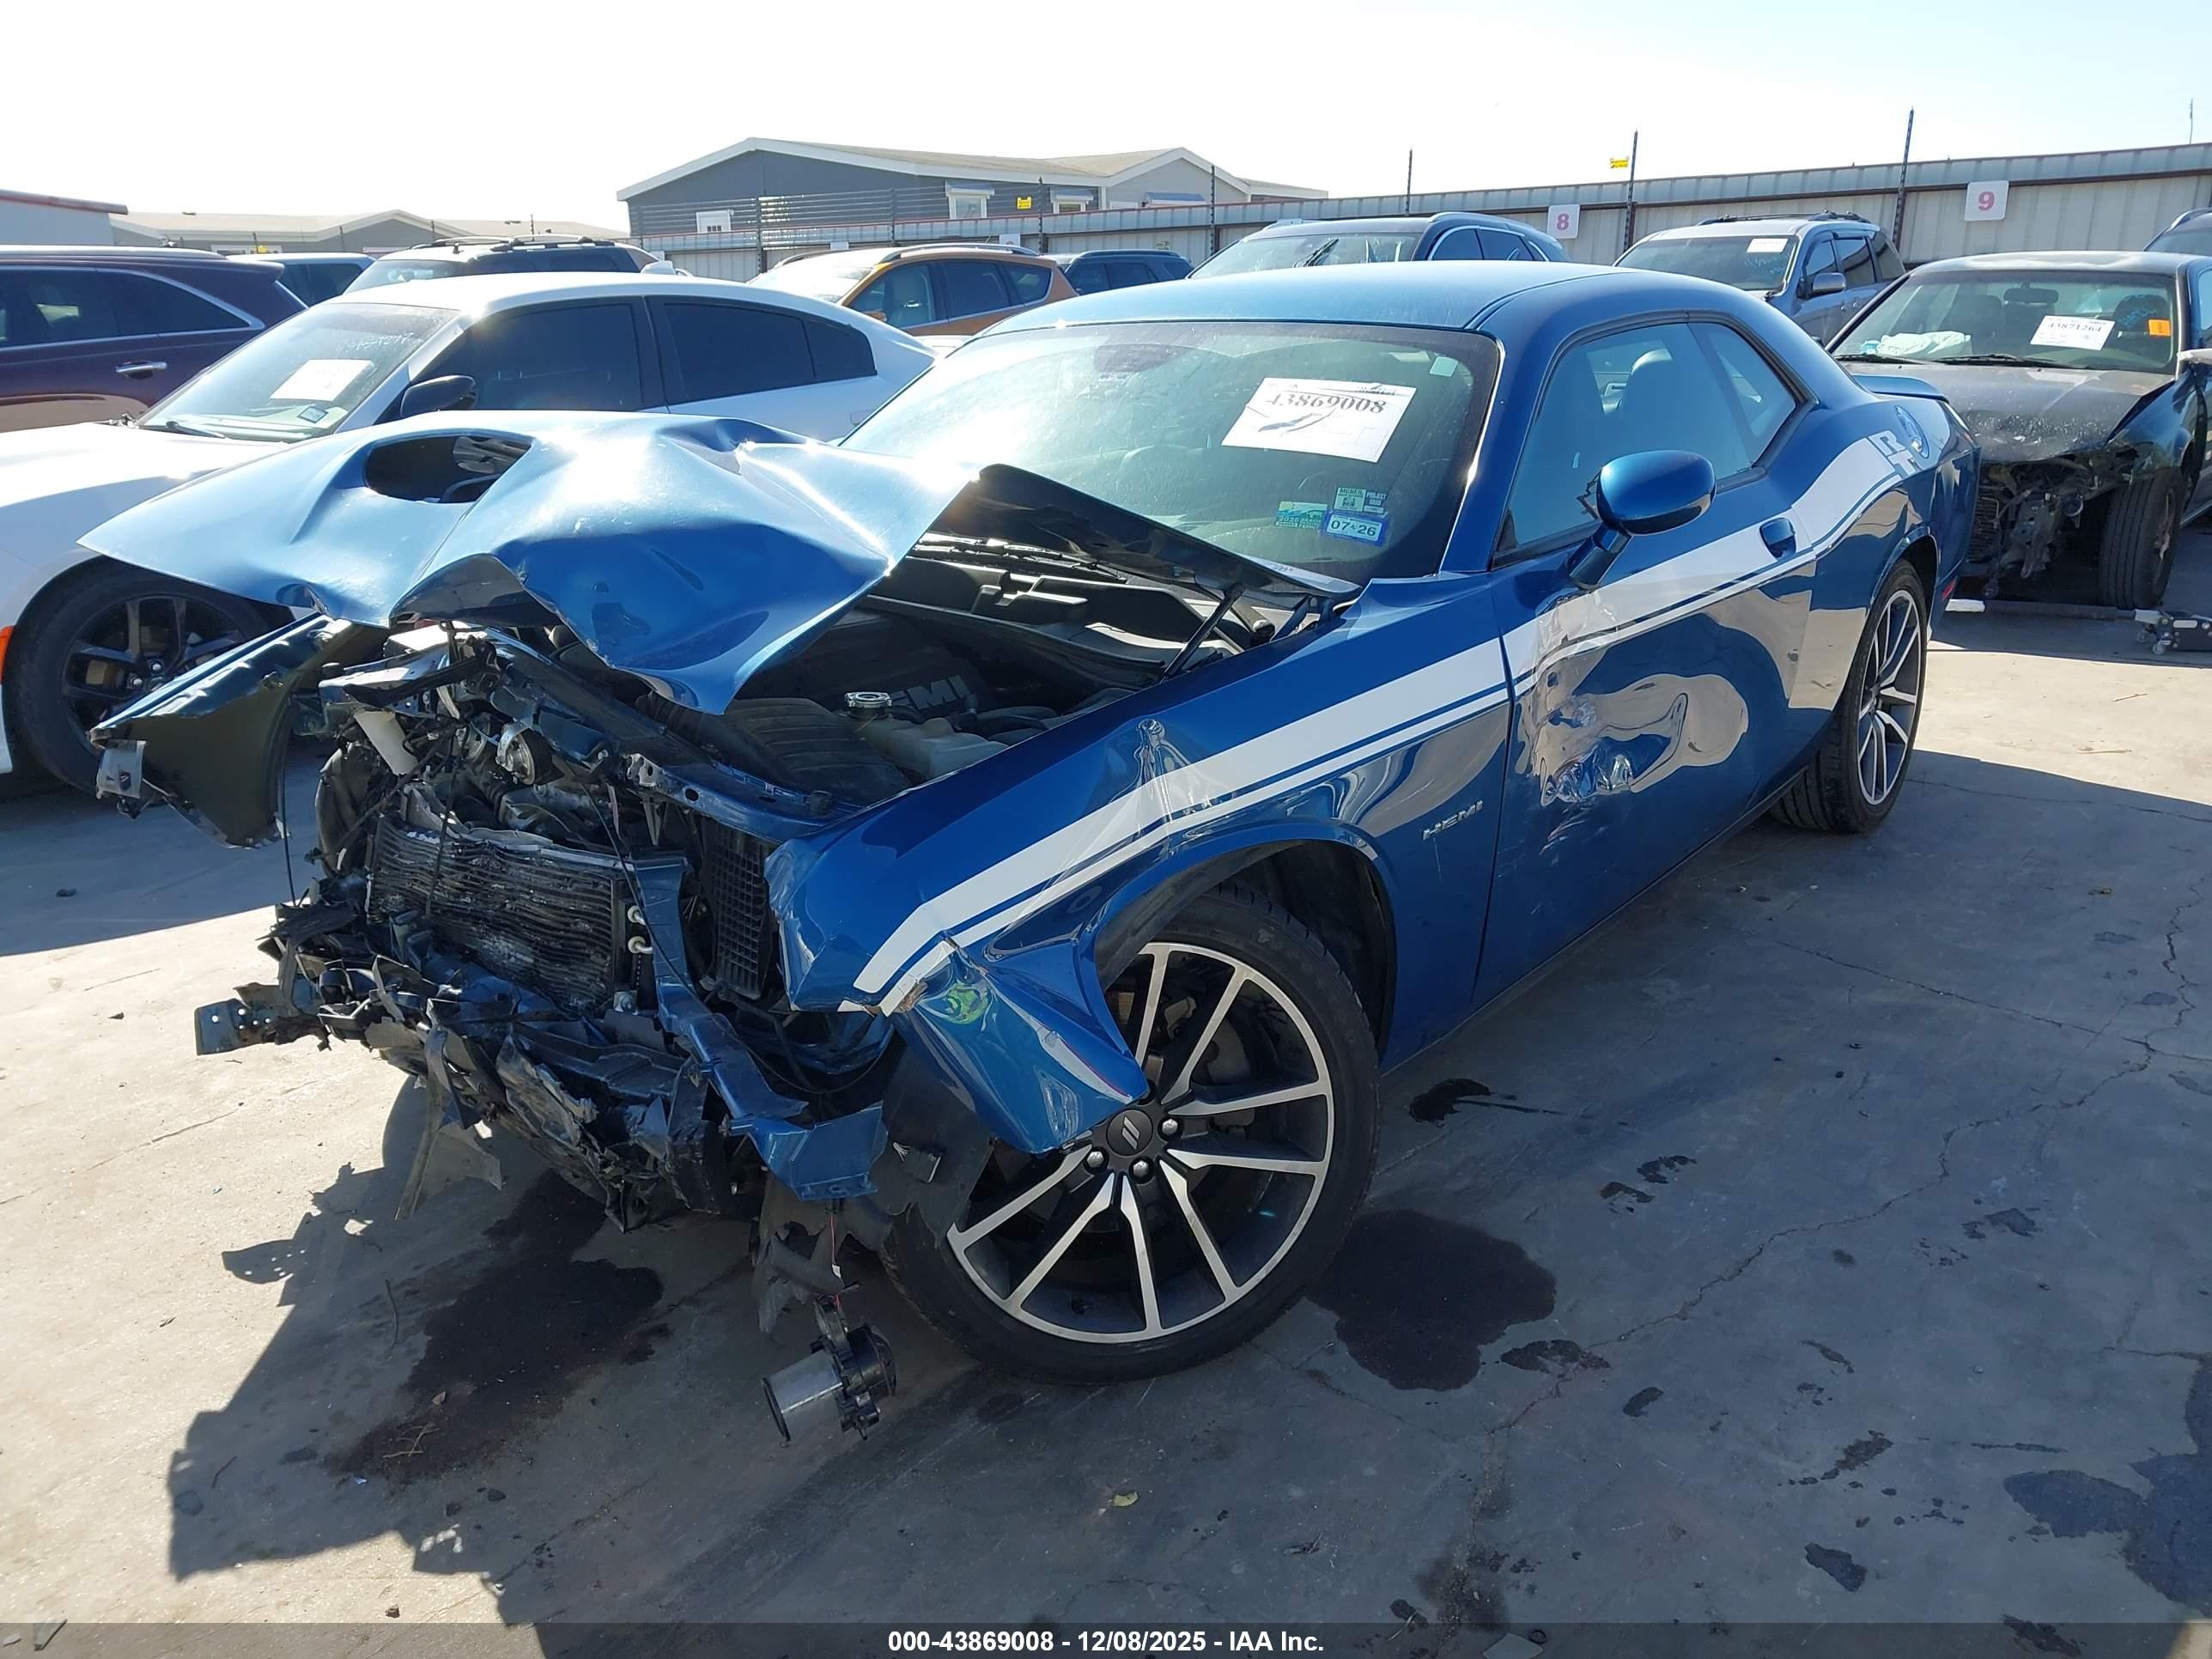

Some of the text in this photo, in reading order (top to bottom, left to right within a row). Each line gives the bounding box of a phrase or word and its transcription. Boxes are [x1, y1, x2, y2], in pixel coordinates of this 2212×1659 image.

[1978, 191, 1996, 212] 9
[1556, 213, 1571, 232] 8
[1266, 392, 1388, 414] 43869008
[1331, 520, 1376, 537] 07 26
[1422, 799, 1484, 841] HEMI
